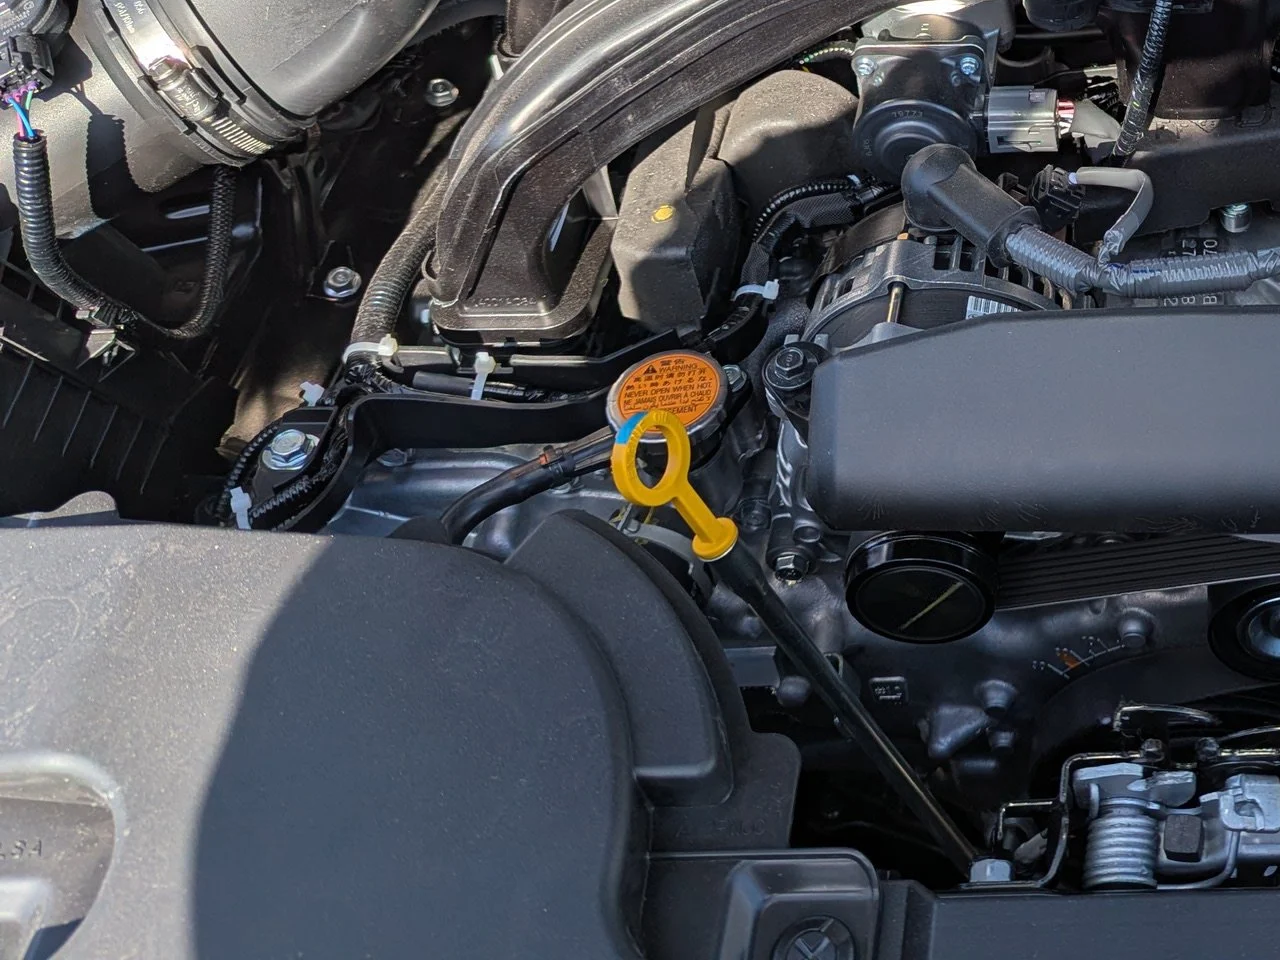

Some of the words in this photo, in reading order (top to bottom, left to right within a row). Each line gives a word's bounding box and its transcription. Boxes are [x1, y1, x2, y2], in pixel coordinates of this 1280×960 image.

[658, 363, 698, 374] WARNING
[624, 390, 648, 398] NEVER
[650, 388, 670, 396] OPEN
